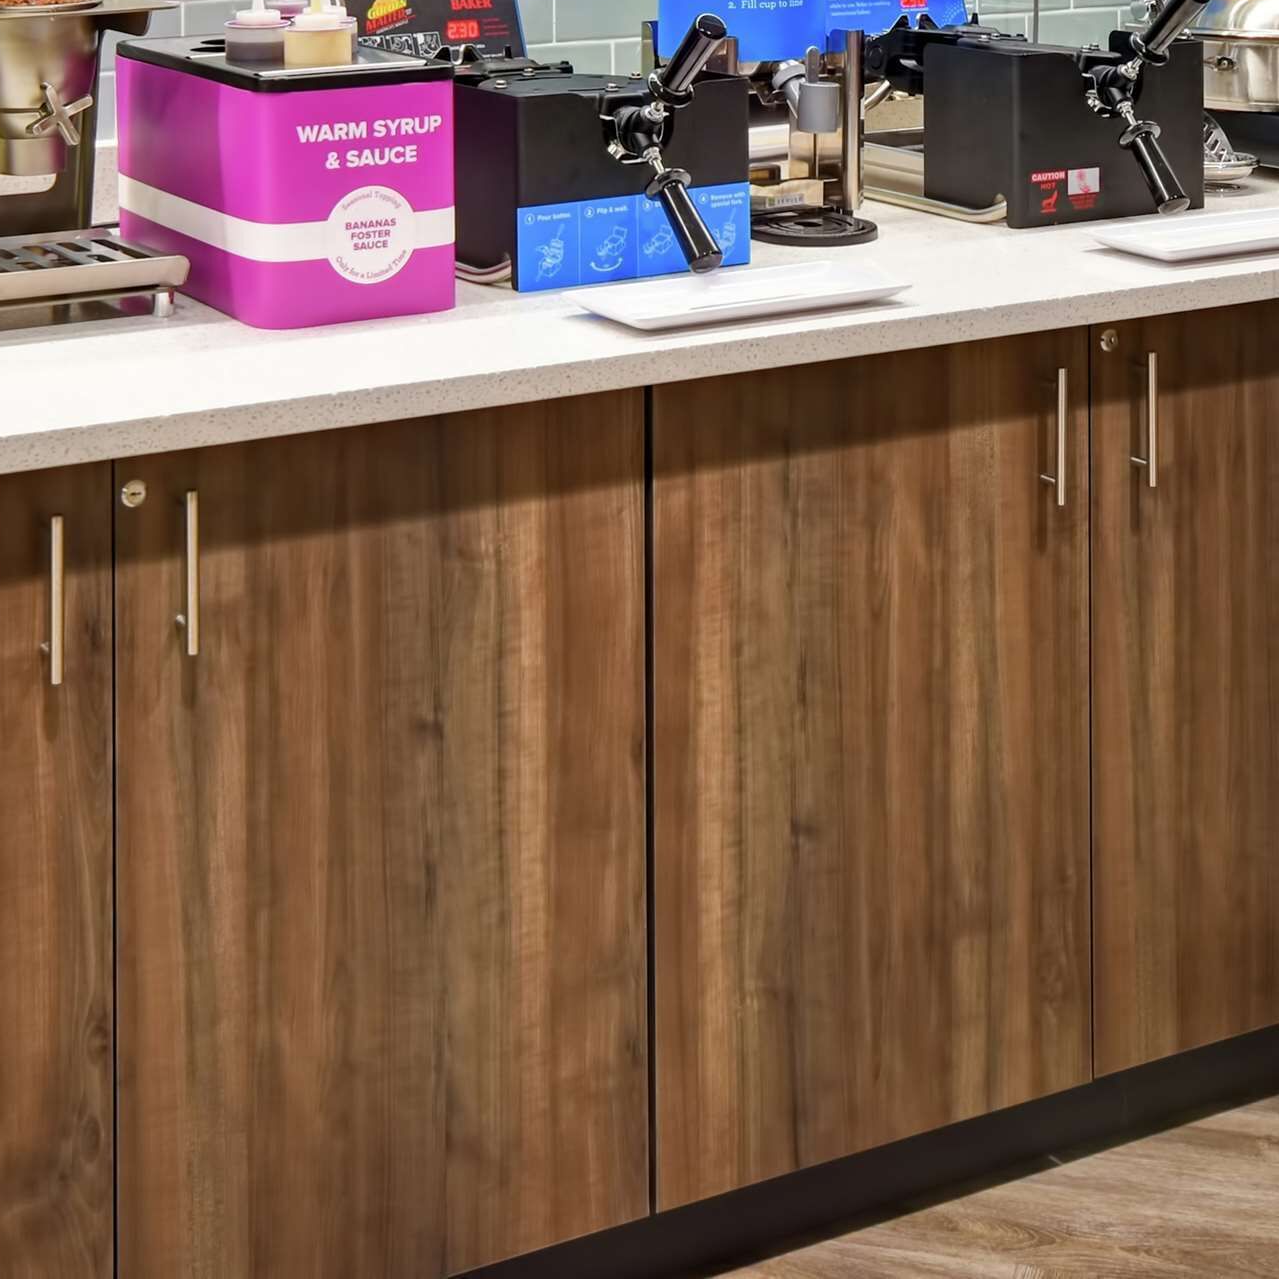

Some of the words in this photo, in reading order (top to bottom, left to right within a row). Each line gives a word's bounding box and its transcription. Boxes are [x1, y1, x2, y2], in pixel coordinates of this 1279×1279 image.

[728, 1, 736, 9] 2.
[741, 0, 756, 9] Fill
[758, 0, 776, 10] cup
[778, 0, 787, 8] to
[296, 121, 367, 143] WARM
[373, 115, 442, 138] SYRUP
[325, 152, 340, 169] &
[346, 145, 417, 168] SAUCE
[1031, 170, 1066, 182] CAUTION
[1041, 182, 1056, 190] HOT
[342, 191, 373, 211] Seasonal
[375, 191, 402, 209] Topping
[345, 218, 397, 230] BANANAS
[351, 230, 391, 240] FOSTER
[353, 240, 388, 250] SAUCE
[336, 256, 349, 272] Only
[348, 267, 359, 277] for
[367, 264, 394, 278] Limited
[392, 249, 407, 266] Time
